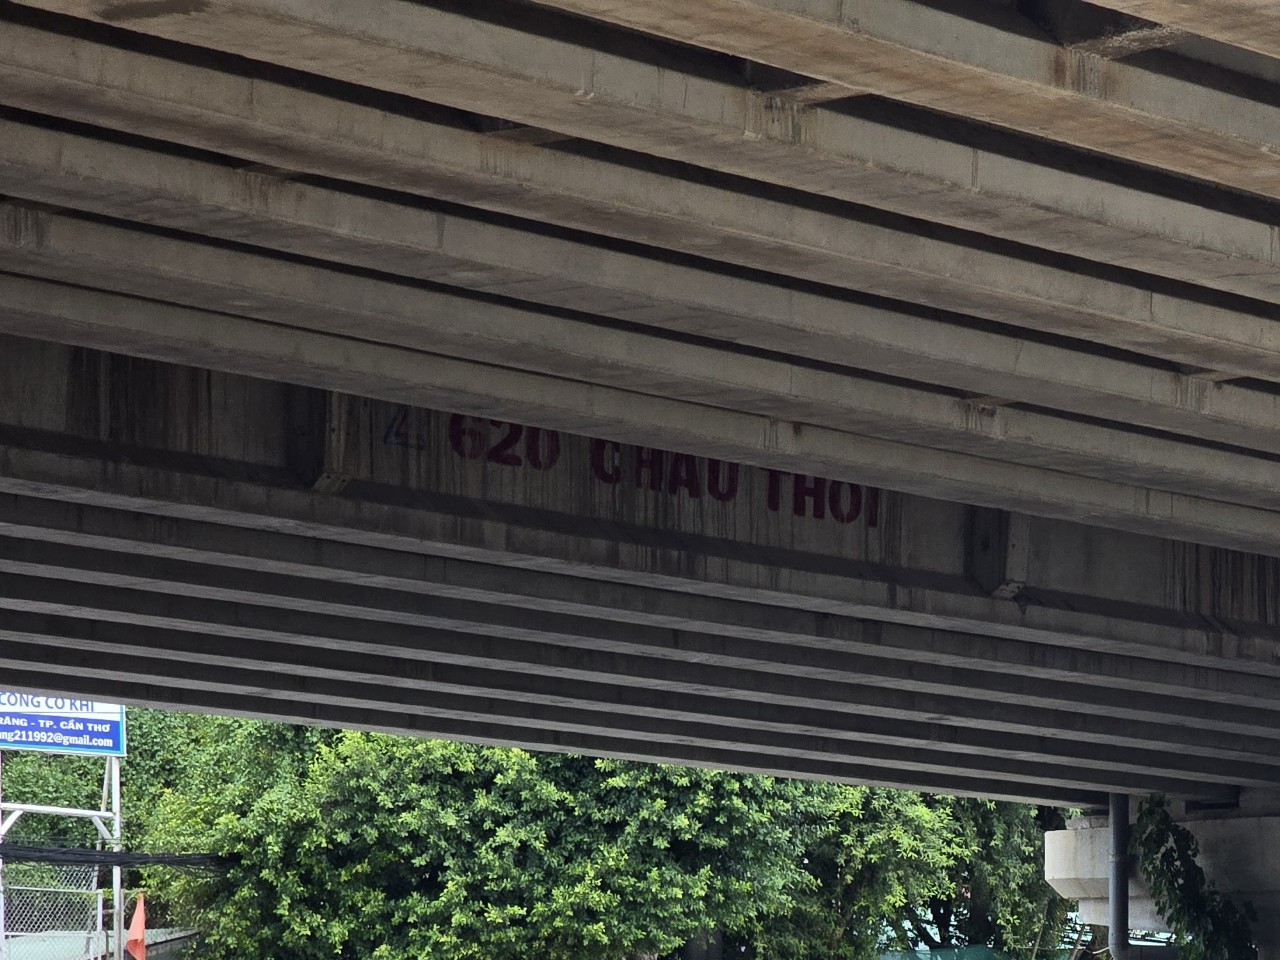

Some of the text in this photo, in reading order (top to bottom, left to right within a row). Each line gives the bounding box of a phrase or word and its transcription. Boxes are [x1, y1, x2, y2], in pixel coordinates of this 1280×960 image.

[447, 412, 561, 470] 620
[38, 720, 57, 729] TP.
[87, 723, 111, 733] THƠ
[0, 730, 113, 748] ng211992@gmail.com
